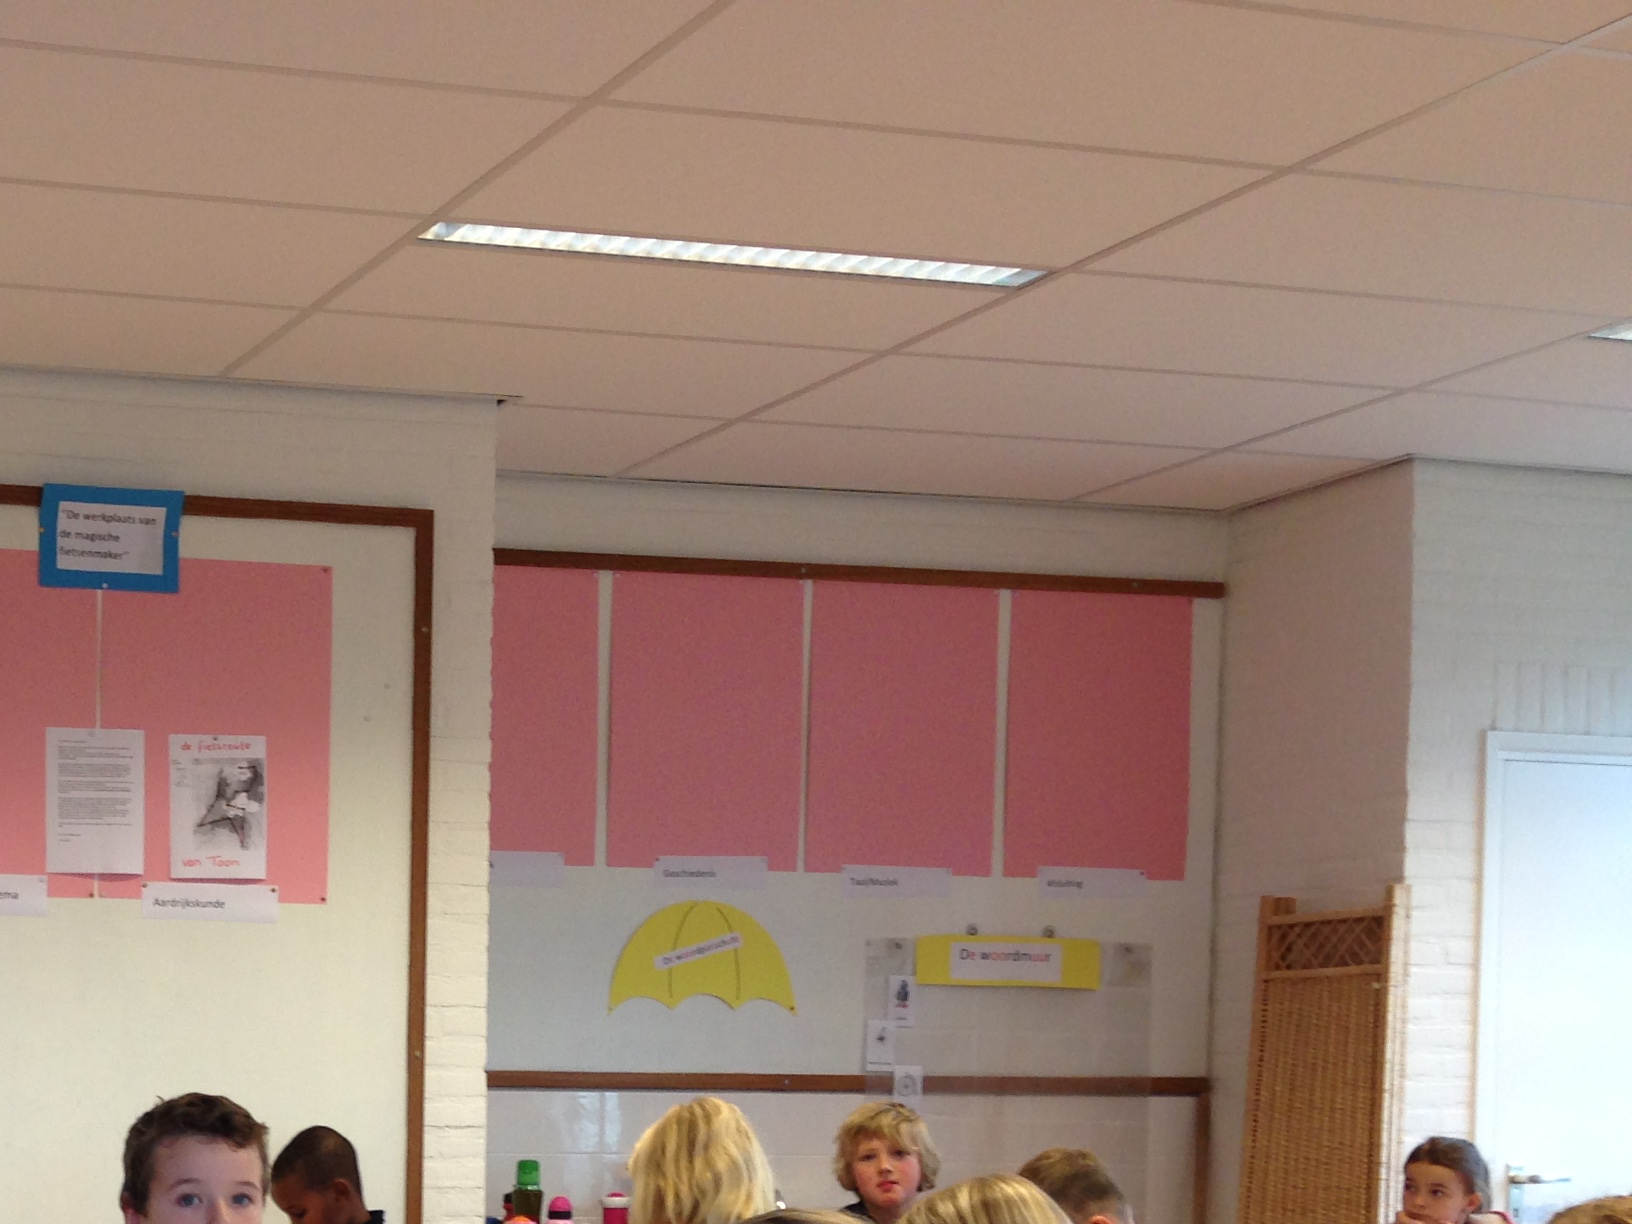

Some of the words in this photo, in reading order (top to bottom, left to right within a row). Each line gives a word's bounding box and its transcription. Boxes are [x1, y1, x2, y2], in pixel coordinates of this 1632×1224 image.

[83, 512, 136, 526] werkplaats
[139, 517, 157, 526] van
[59, 529, 72, 539] de
[75, 530, 121, 543] magische
[959, 948, 976, 961] De
[980, 948, 1052, 962] woordmuur
